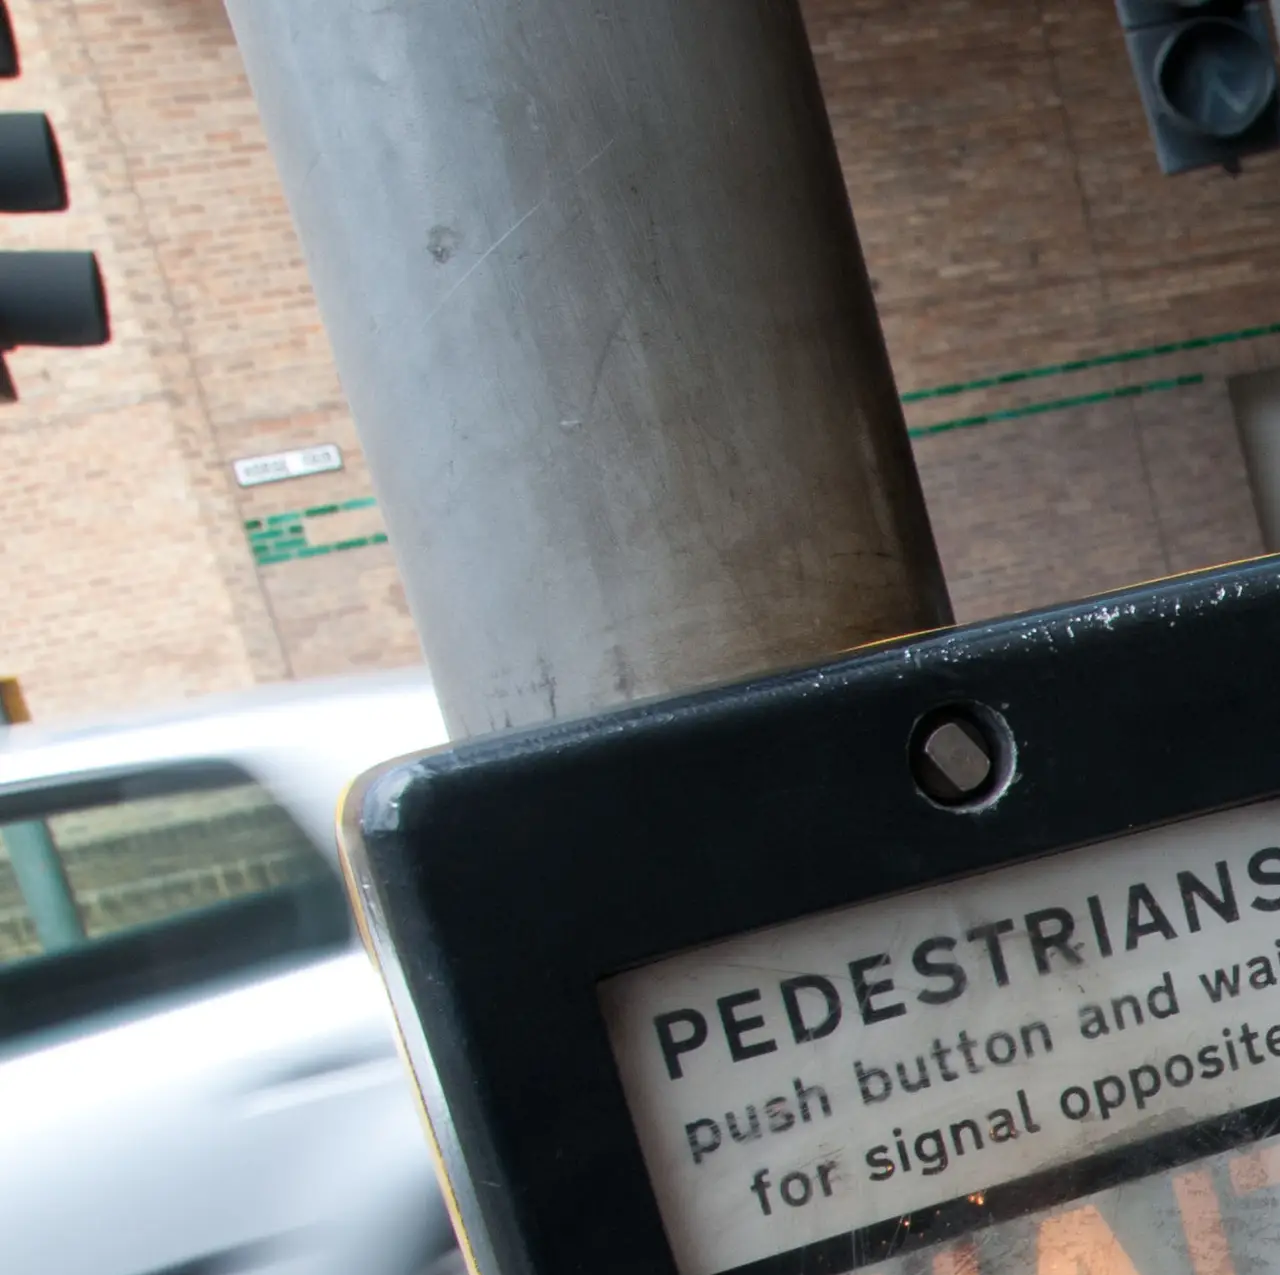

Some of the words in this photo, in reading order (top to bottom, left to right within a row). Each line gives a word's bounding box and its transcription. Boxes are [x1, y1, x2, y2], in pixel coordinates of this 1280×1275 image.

[684, 1078, 834, 1163] push
[853, 1013, 1054, 1105] button
[1079, 973, 1180, 1038] and
[750, 1162, 838, 1216] for
[864, 1091, 1041, 1184] signal
